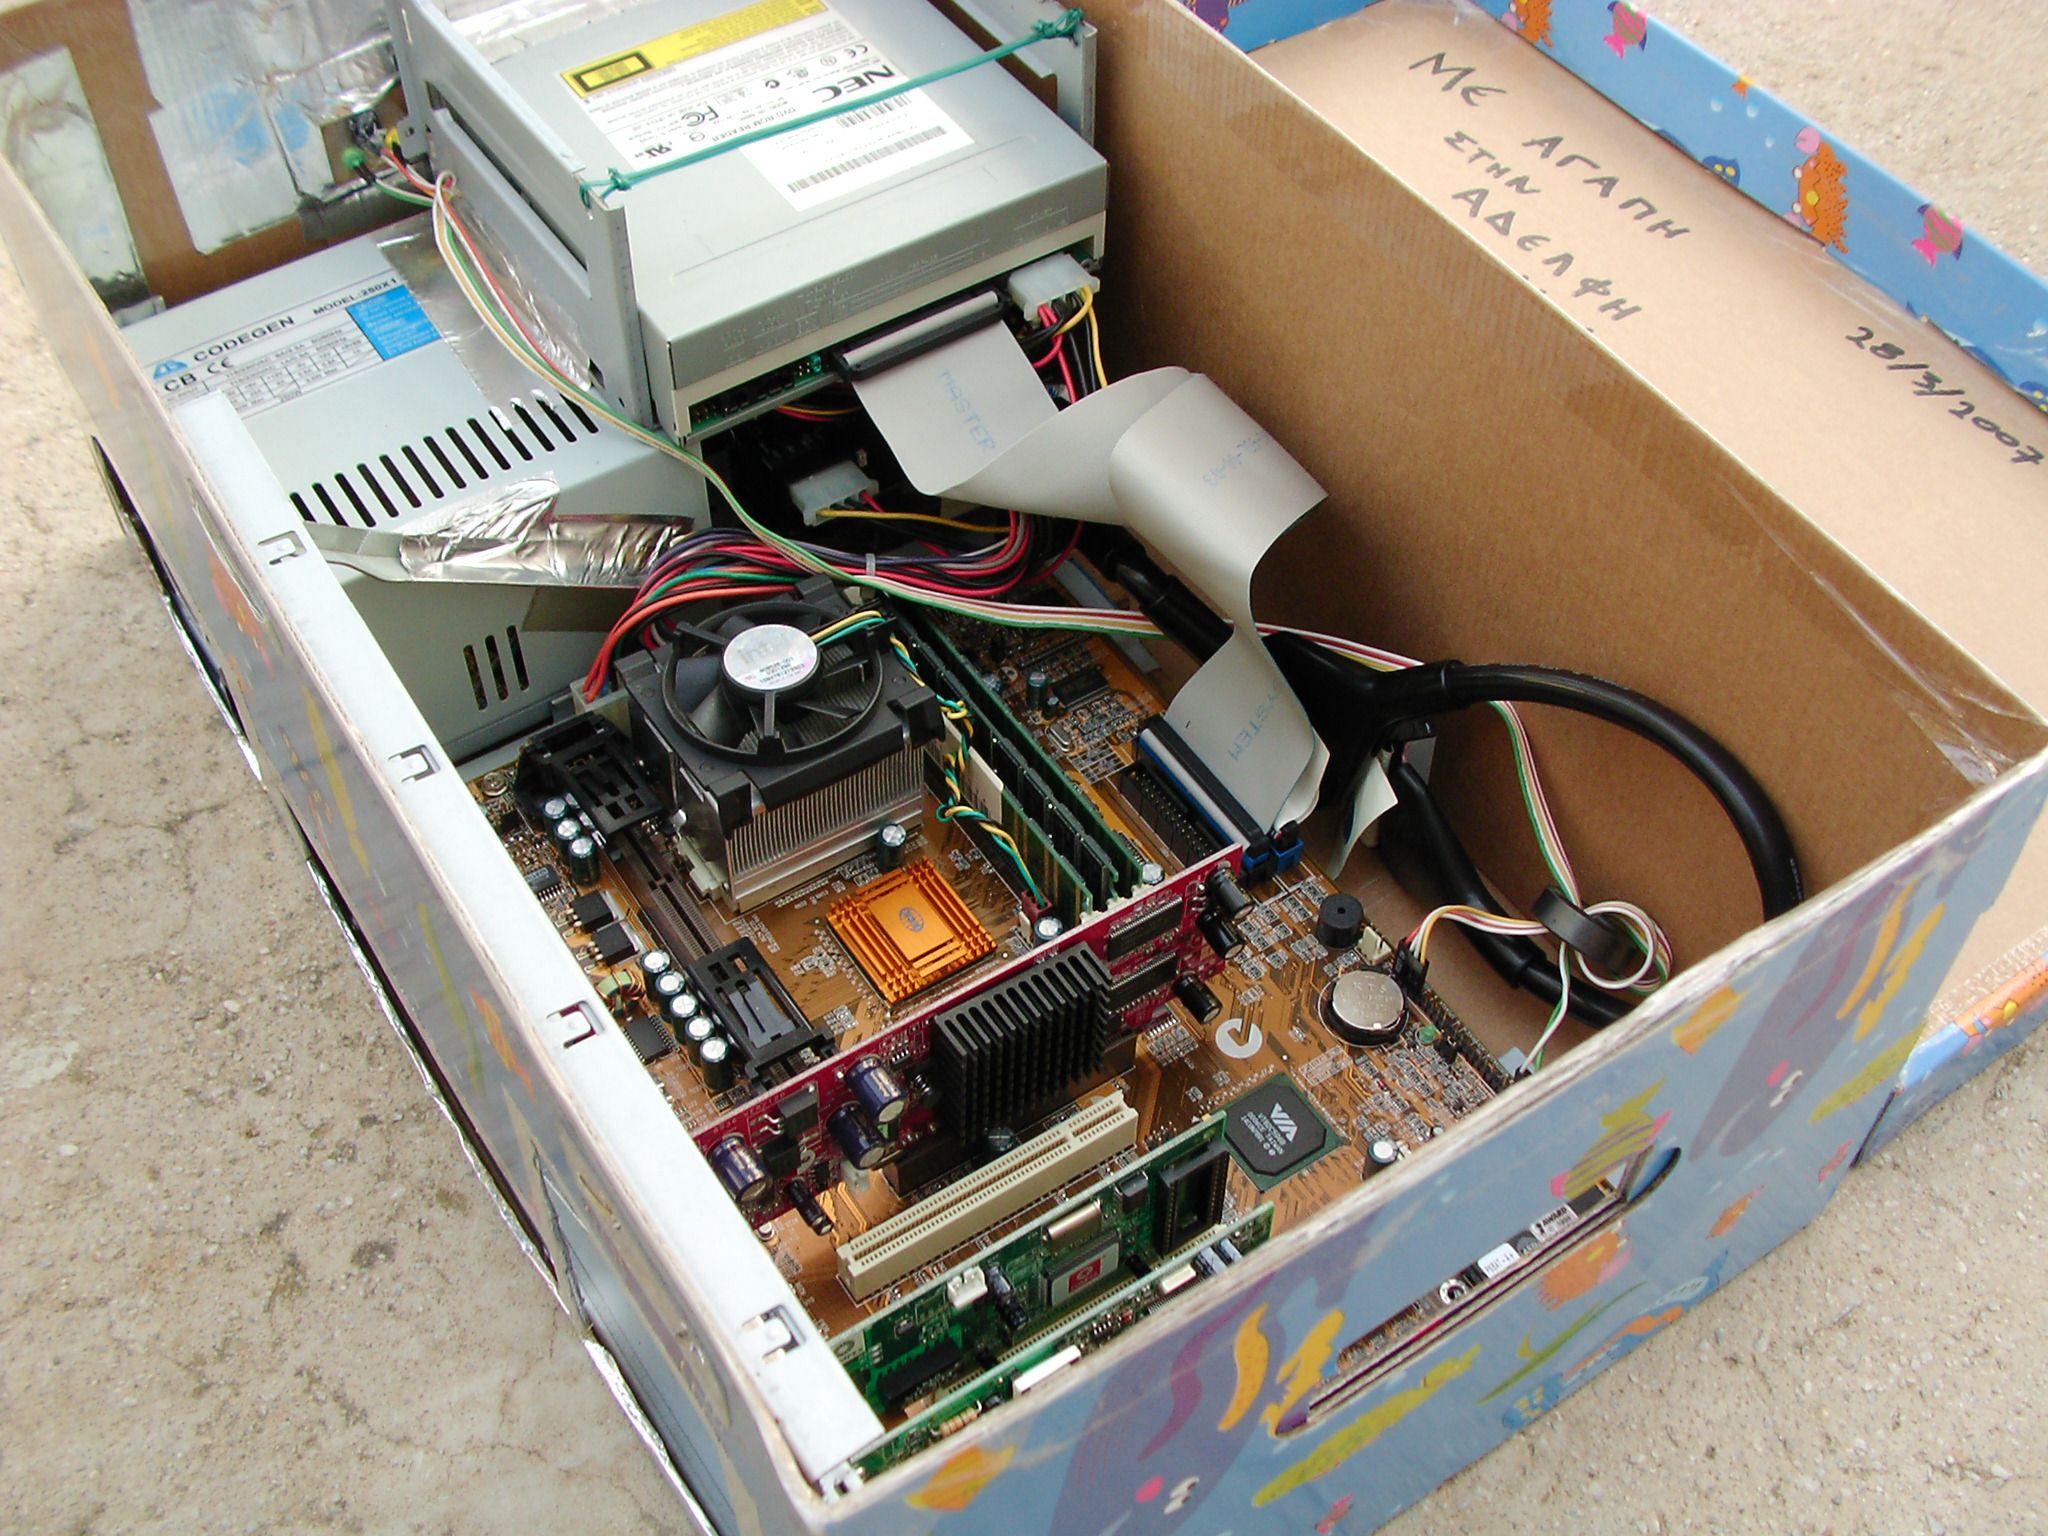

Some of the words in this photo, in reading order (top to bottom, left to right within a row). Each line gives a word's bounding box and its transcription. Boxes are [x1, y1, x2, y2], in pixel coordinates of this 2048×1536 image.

[811, 64, 897, 104] NEC
[193, 315, 296, 363] CODEGEN
[163, 372, 198, 393] CB
[1845, 325, 2045, 467] 28/3/2007
[938, 367, 997, 449] MASTER
[1270, 1102, 1298, 1142] VIA
[1541, 1206, 1568, 1227] AWARD
